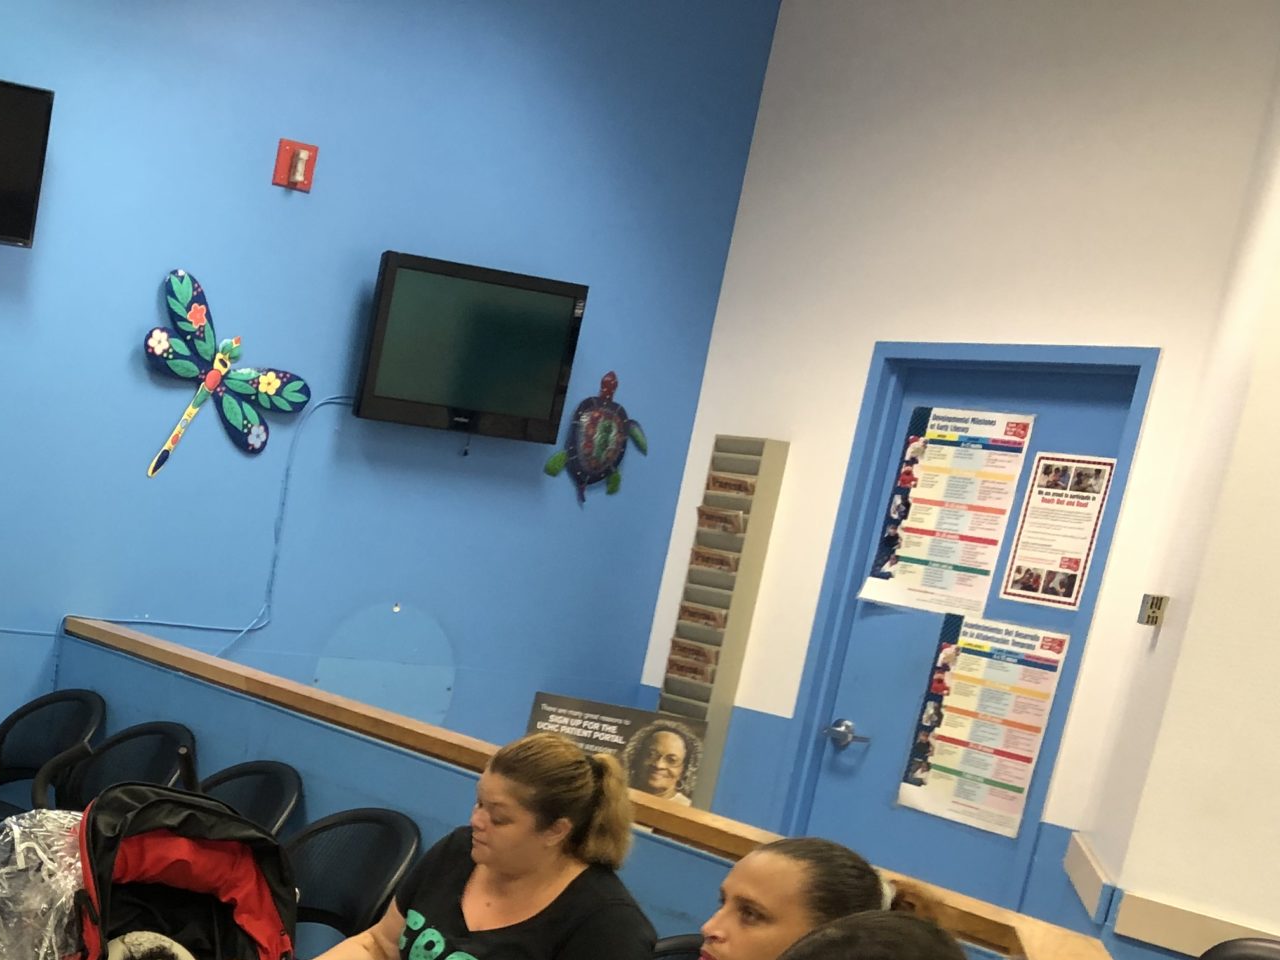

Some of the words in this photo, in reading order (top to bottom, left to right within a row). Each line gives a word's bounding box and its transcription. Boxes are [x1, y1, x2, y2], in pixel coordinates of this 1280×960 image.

[548, 714, 569, 724] SIGN
[569, 718, 583, 726] UP
[582, 720, 600, 730] FOR
[601, 723, 618, 733] THE
[560, 725, 593, 738] PATIENT
